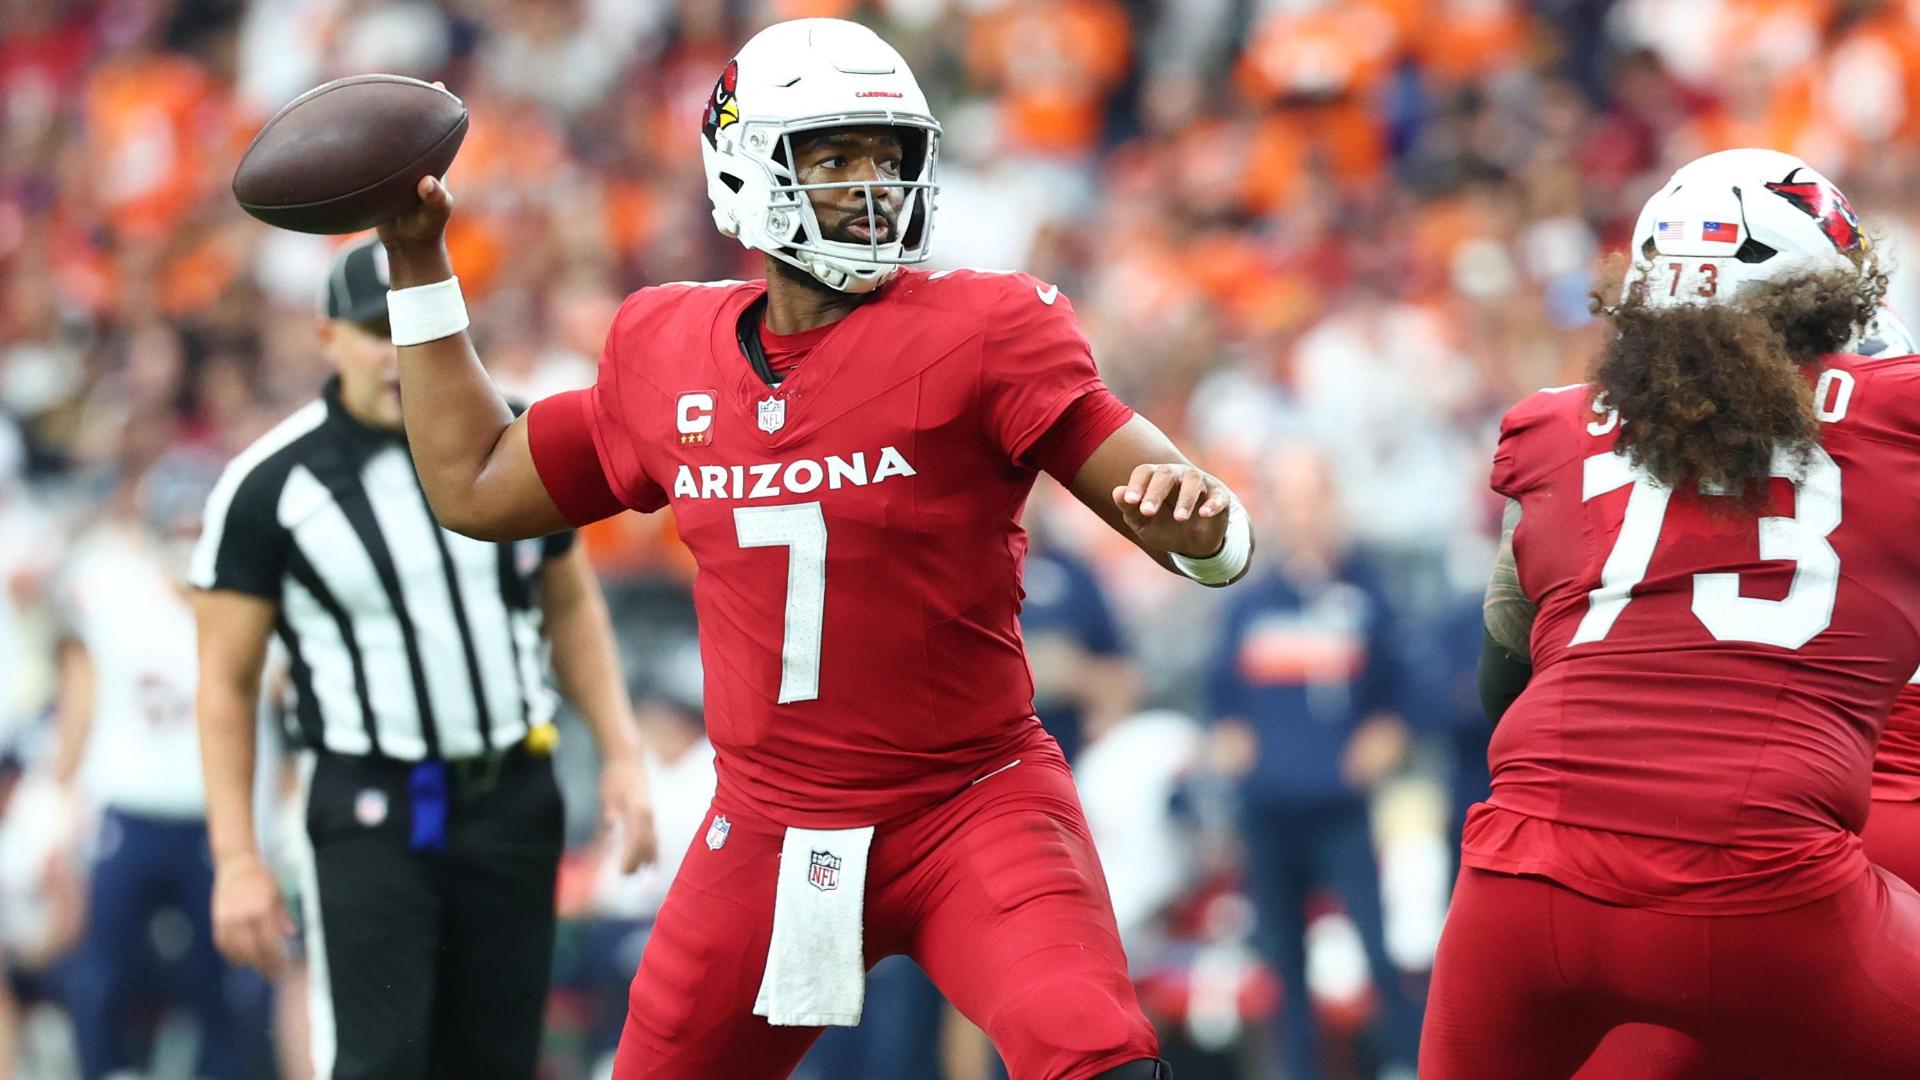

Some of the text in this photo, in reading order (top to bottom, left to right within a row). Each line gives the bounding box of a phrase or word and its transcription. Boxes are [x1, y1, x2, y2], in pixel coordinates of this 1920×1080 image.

[1667, 262, 1718, 297] 73
[677, 394, 713, 433] C
[674, 446, 917, 499] ARIZONA
[1568, 440, 1842, 649] 73
[733, 501, 828, 704] 7
[812, 866, 836, 887] NFL
